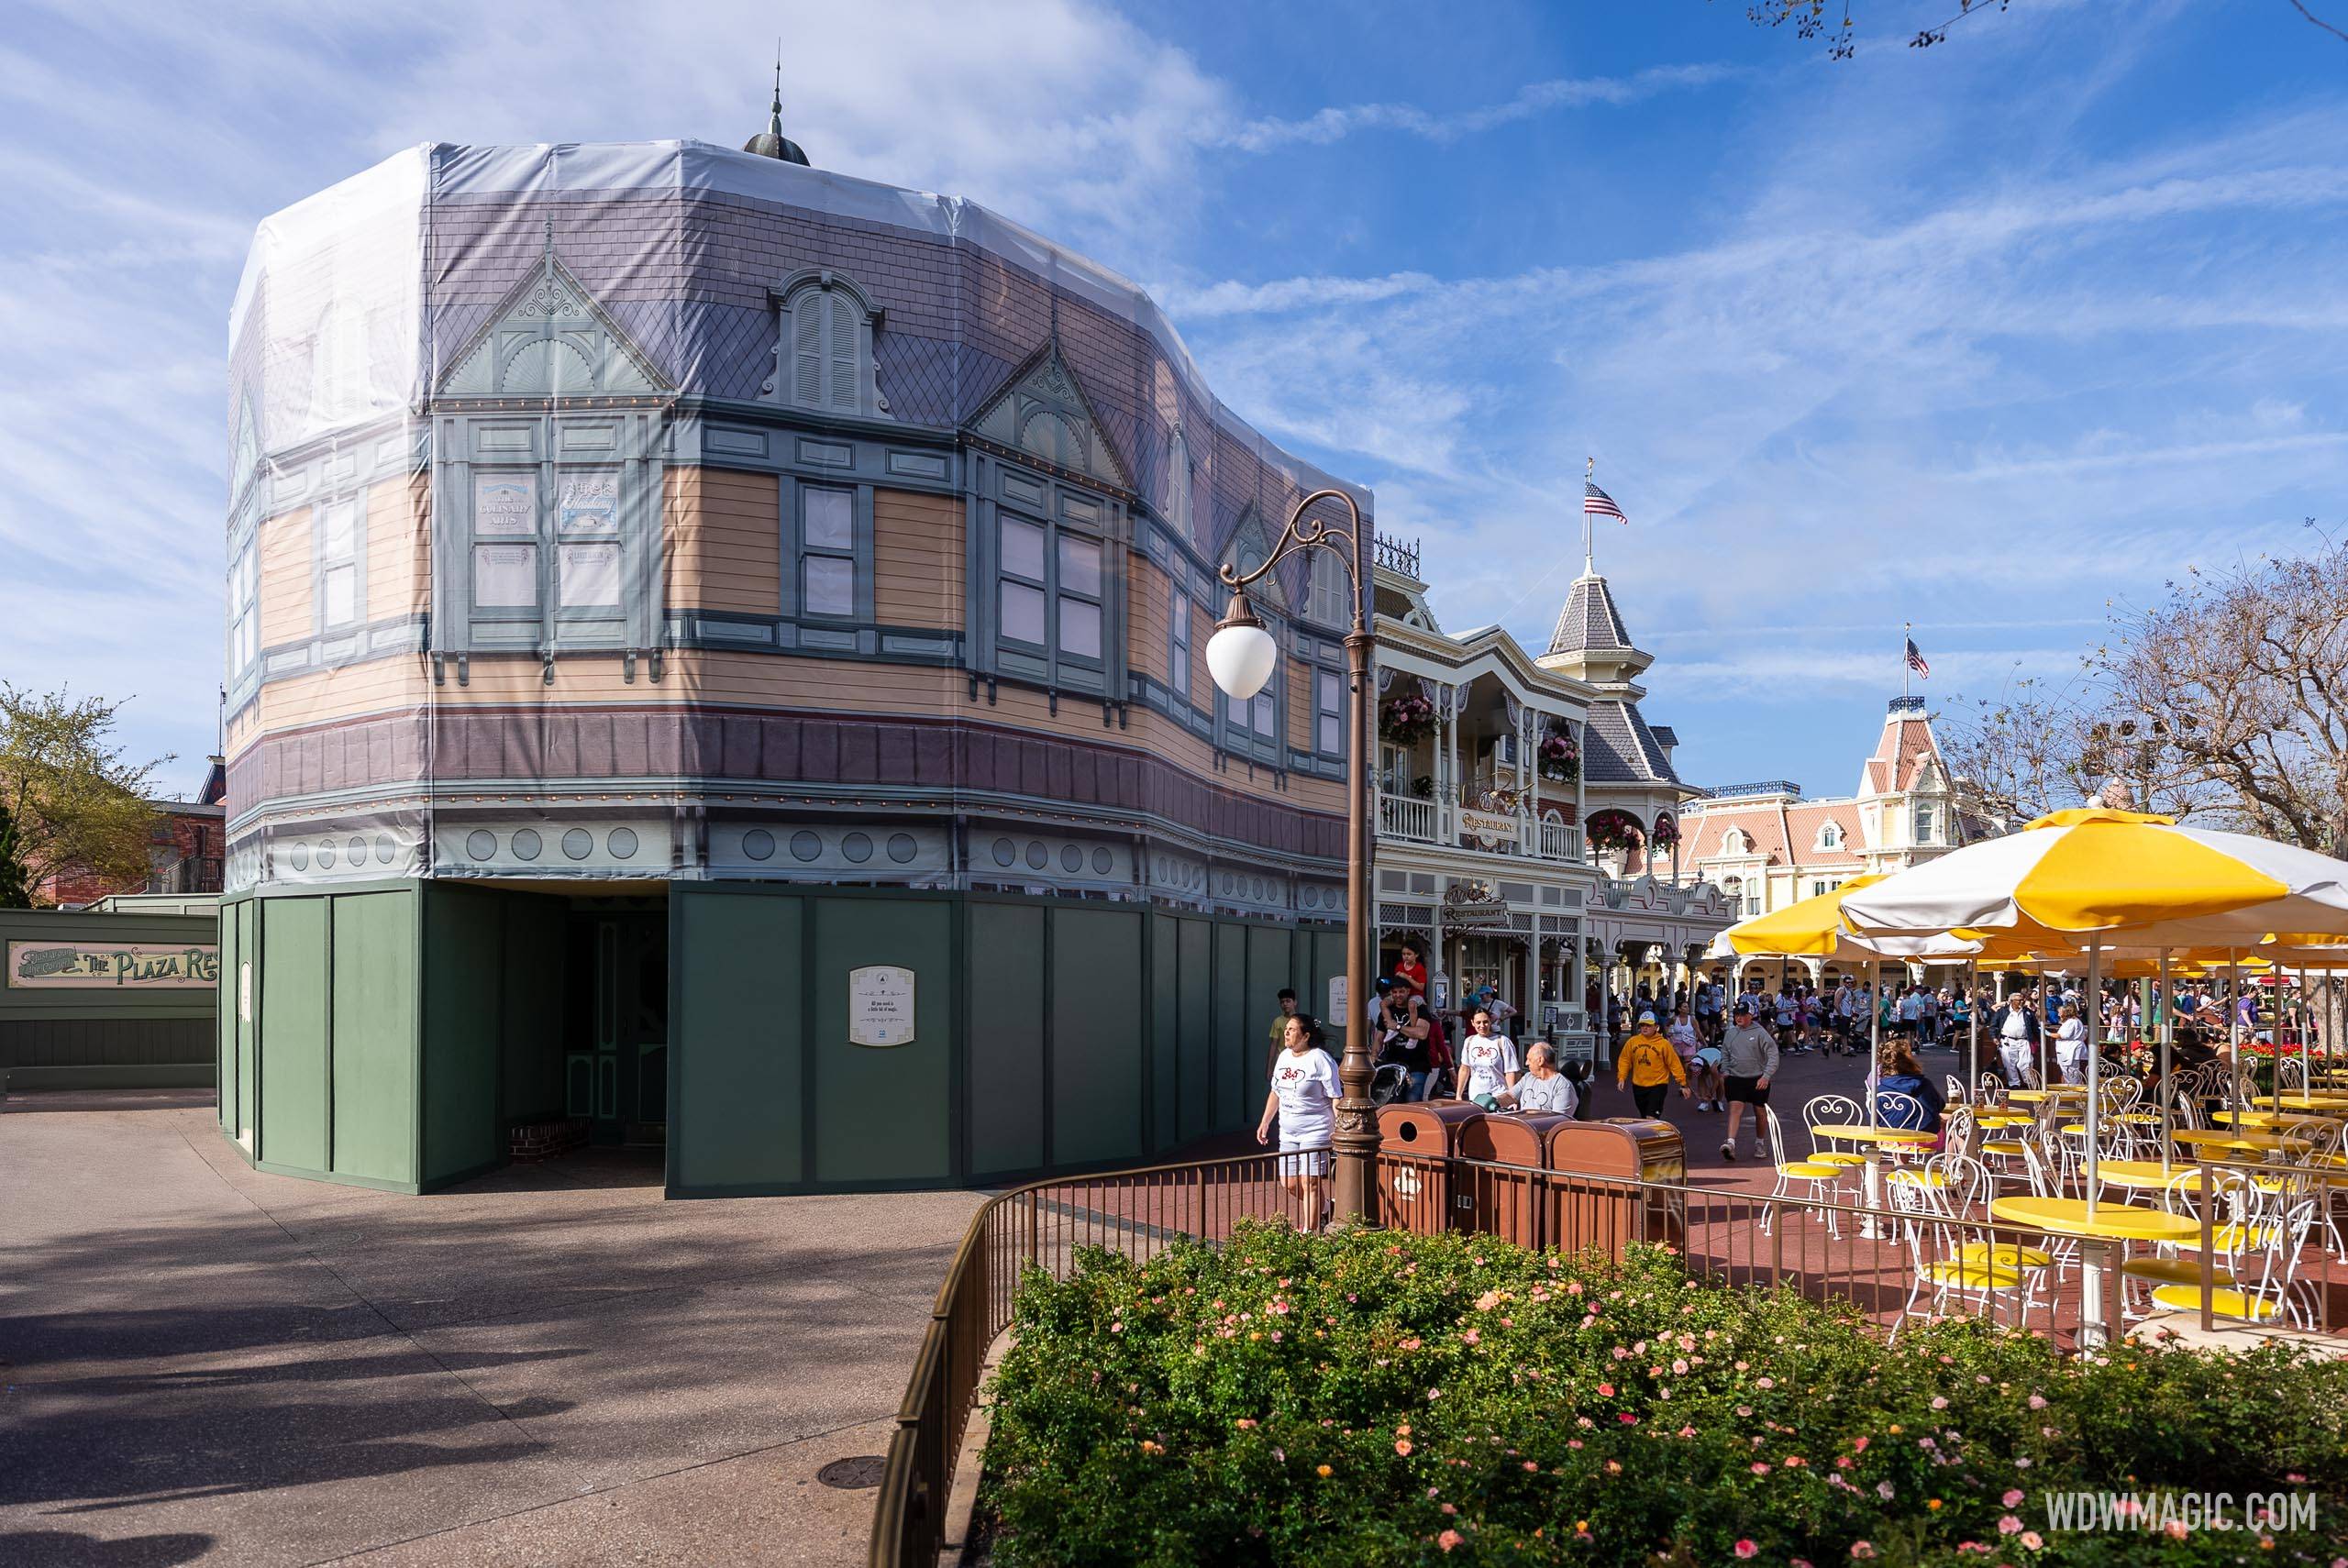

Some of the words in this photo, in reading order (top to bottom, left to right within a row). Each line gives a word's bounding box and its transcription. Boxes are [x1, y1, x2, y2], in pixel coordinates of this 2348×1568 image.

[479, 505, 531, 514] CULINARY
[490, 515, 518, 525] ARTS
[1462, 812, 1514, 834] RESTAURANT
[1443, 907, 1501, 922] RESTAURANT
[83, 954, 109, 972] THE
[111, 950, 180, 986] PLAZA
